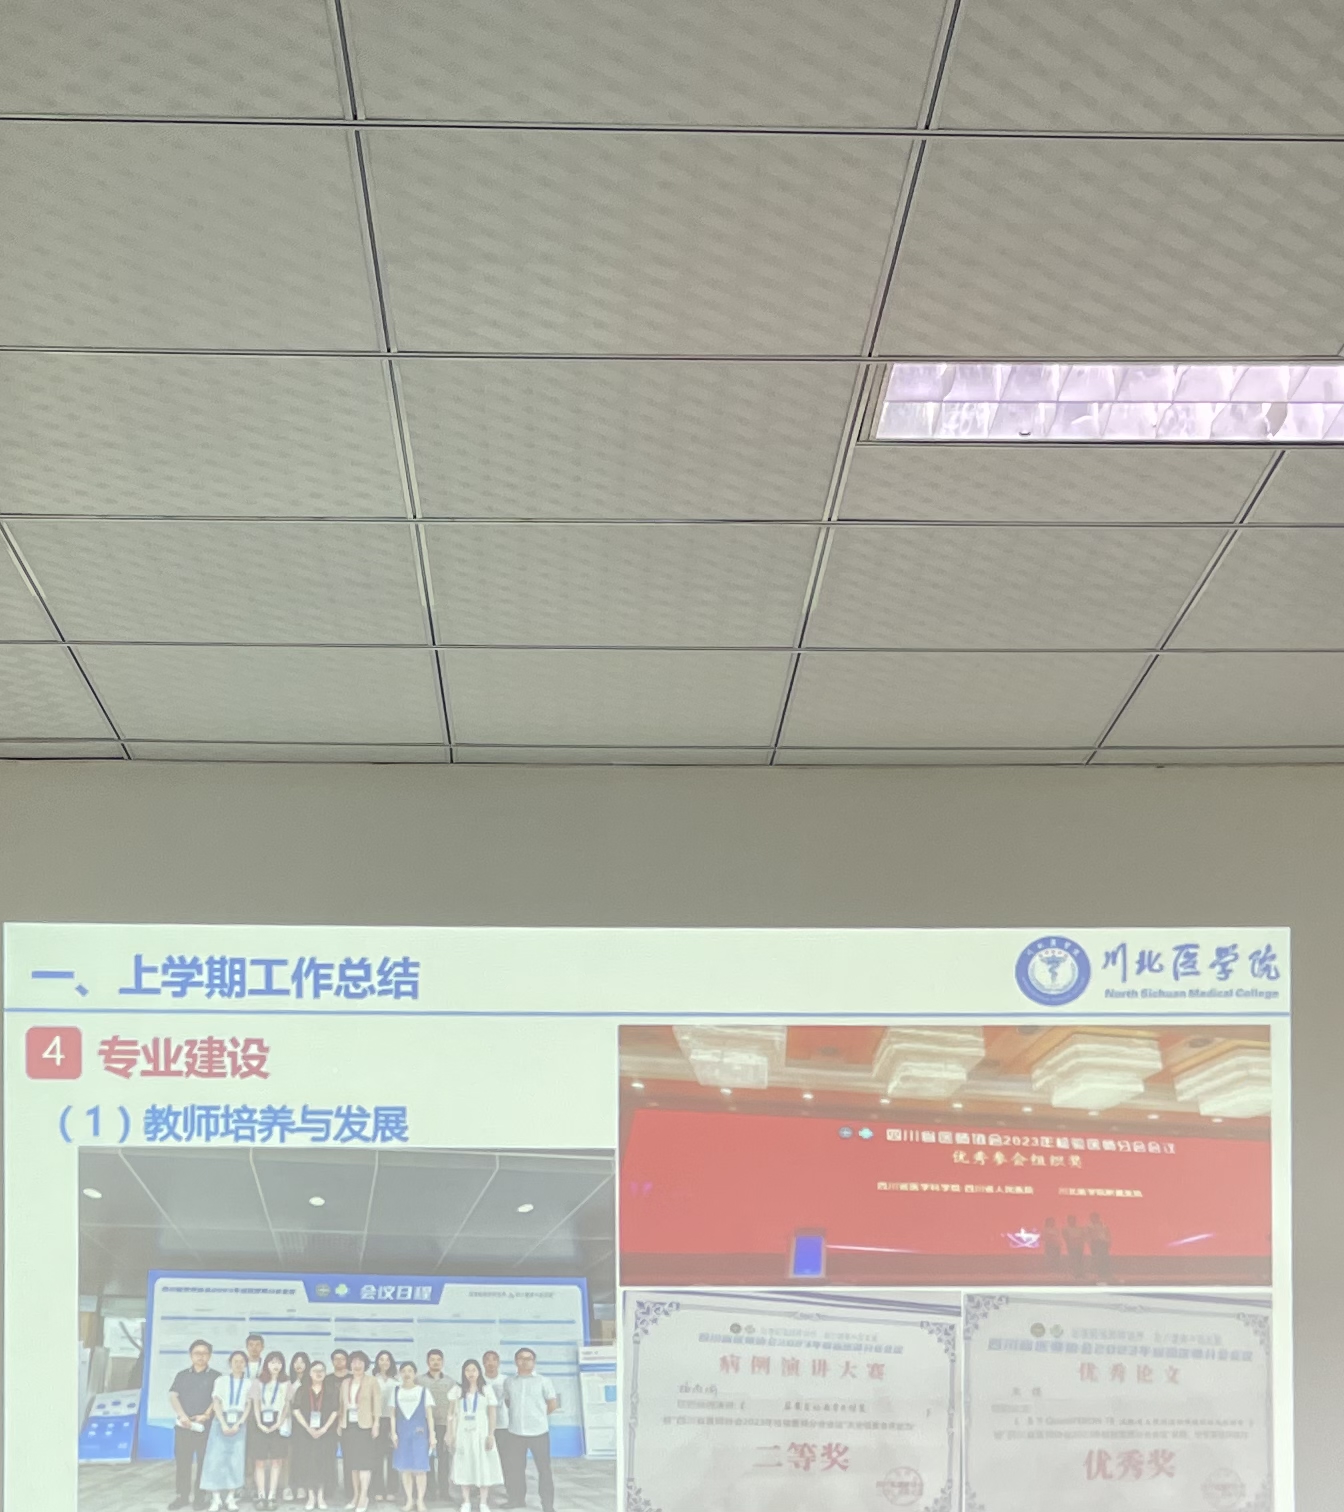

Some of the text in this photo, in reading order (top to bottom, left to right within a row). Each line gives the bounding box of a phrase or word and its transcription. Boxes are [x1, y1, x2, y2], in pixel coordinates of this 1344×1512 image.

[30, 954, 421, 1001] 一、上学期工作总结
[1101, 941, 1281, 984] 川北医学院
[41, 1036, 271, 1080] 4 专业建设
[752, 1441, 851, 1473] 二等奖
[1083, 1448, 1177, 1482] 优秀奖
